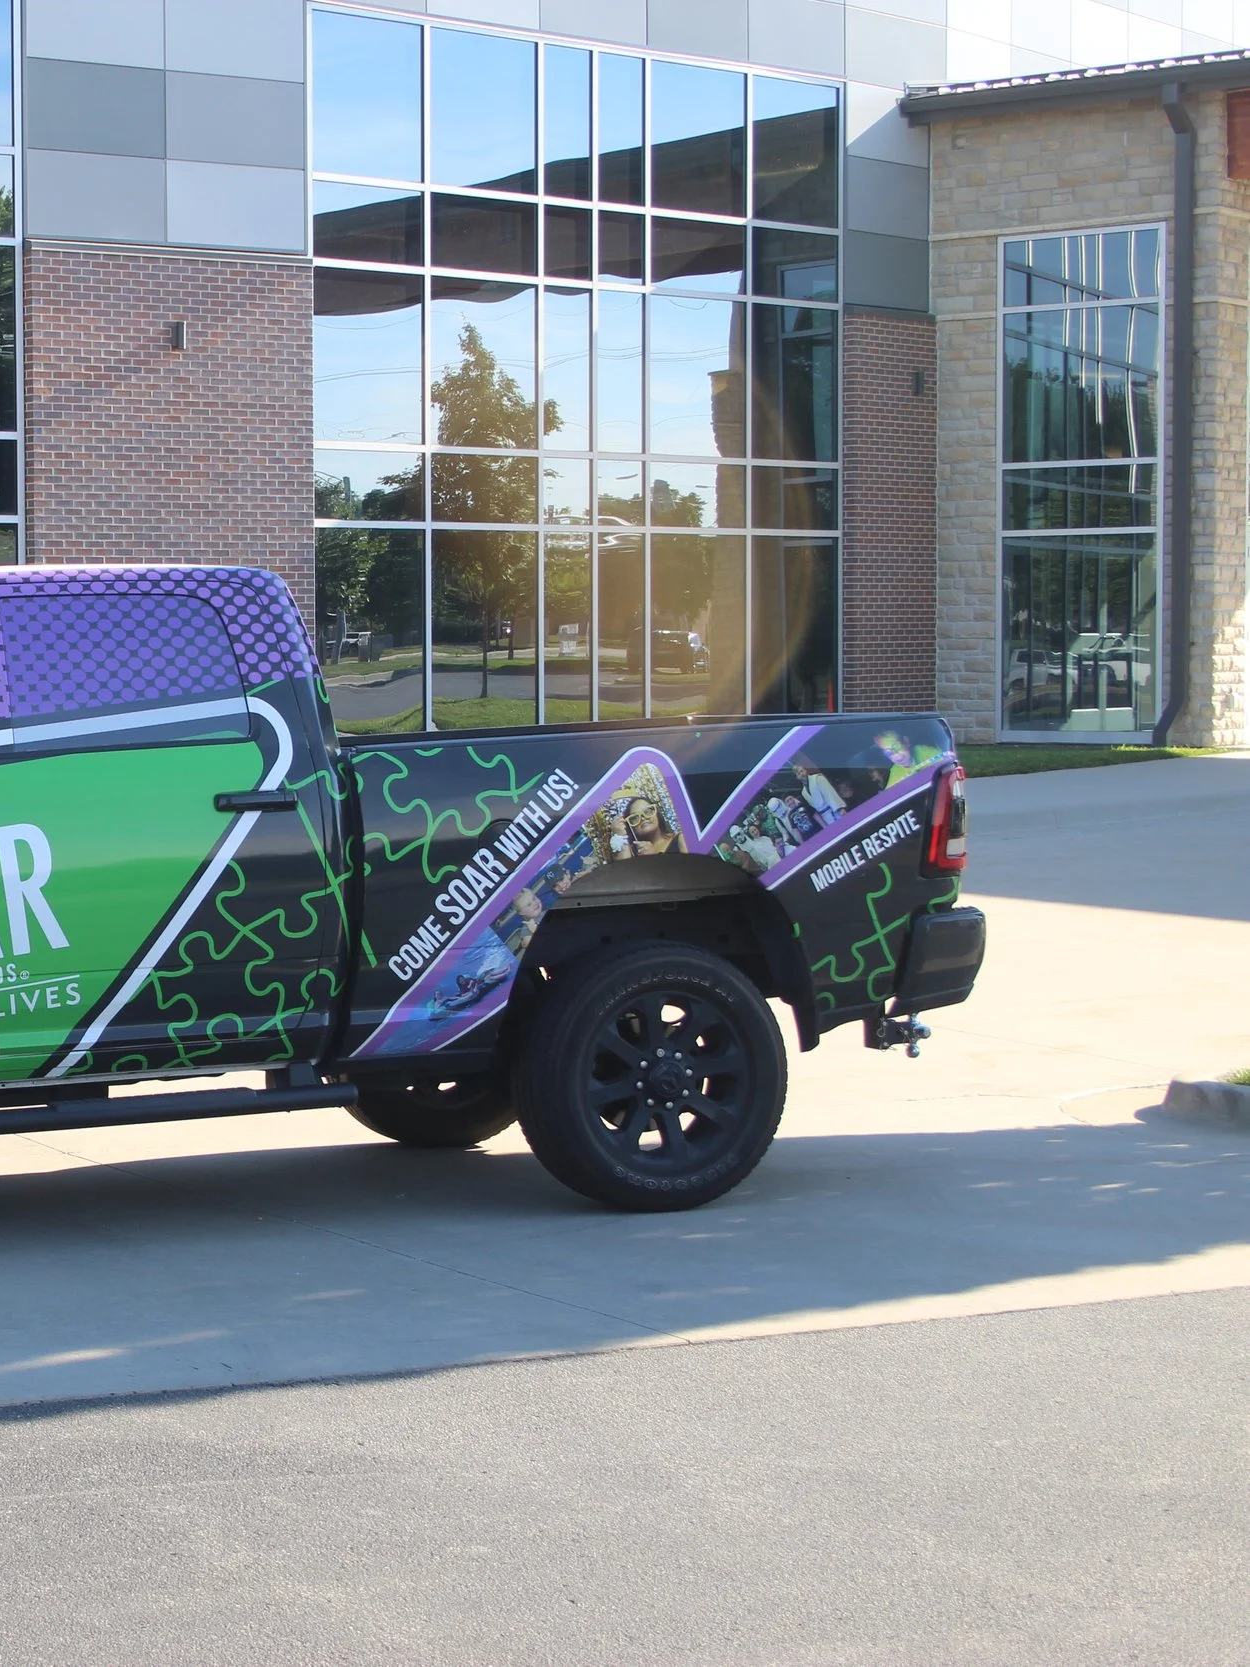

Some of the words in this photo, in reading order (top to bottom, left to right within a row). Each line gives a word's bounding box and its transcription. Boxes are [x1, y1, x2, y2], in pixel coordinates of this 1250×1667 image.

[387, 914, 450, 981] COME
[435, 847, 508, 926] SOAR
[493, 800, 552, 863] WITH
[539, 768, 580, 812] US!
[809, 845, 866, 892] MOBILE
[861, 809, 920, 860] RESPITE
